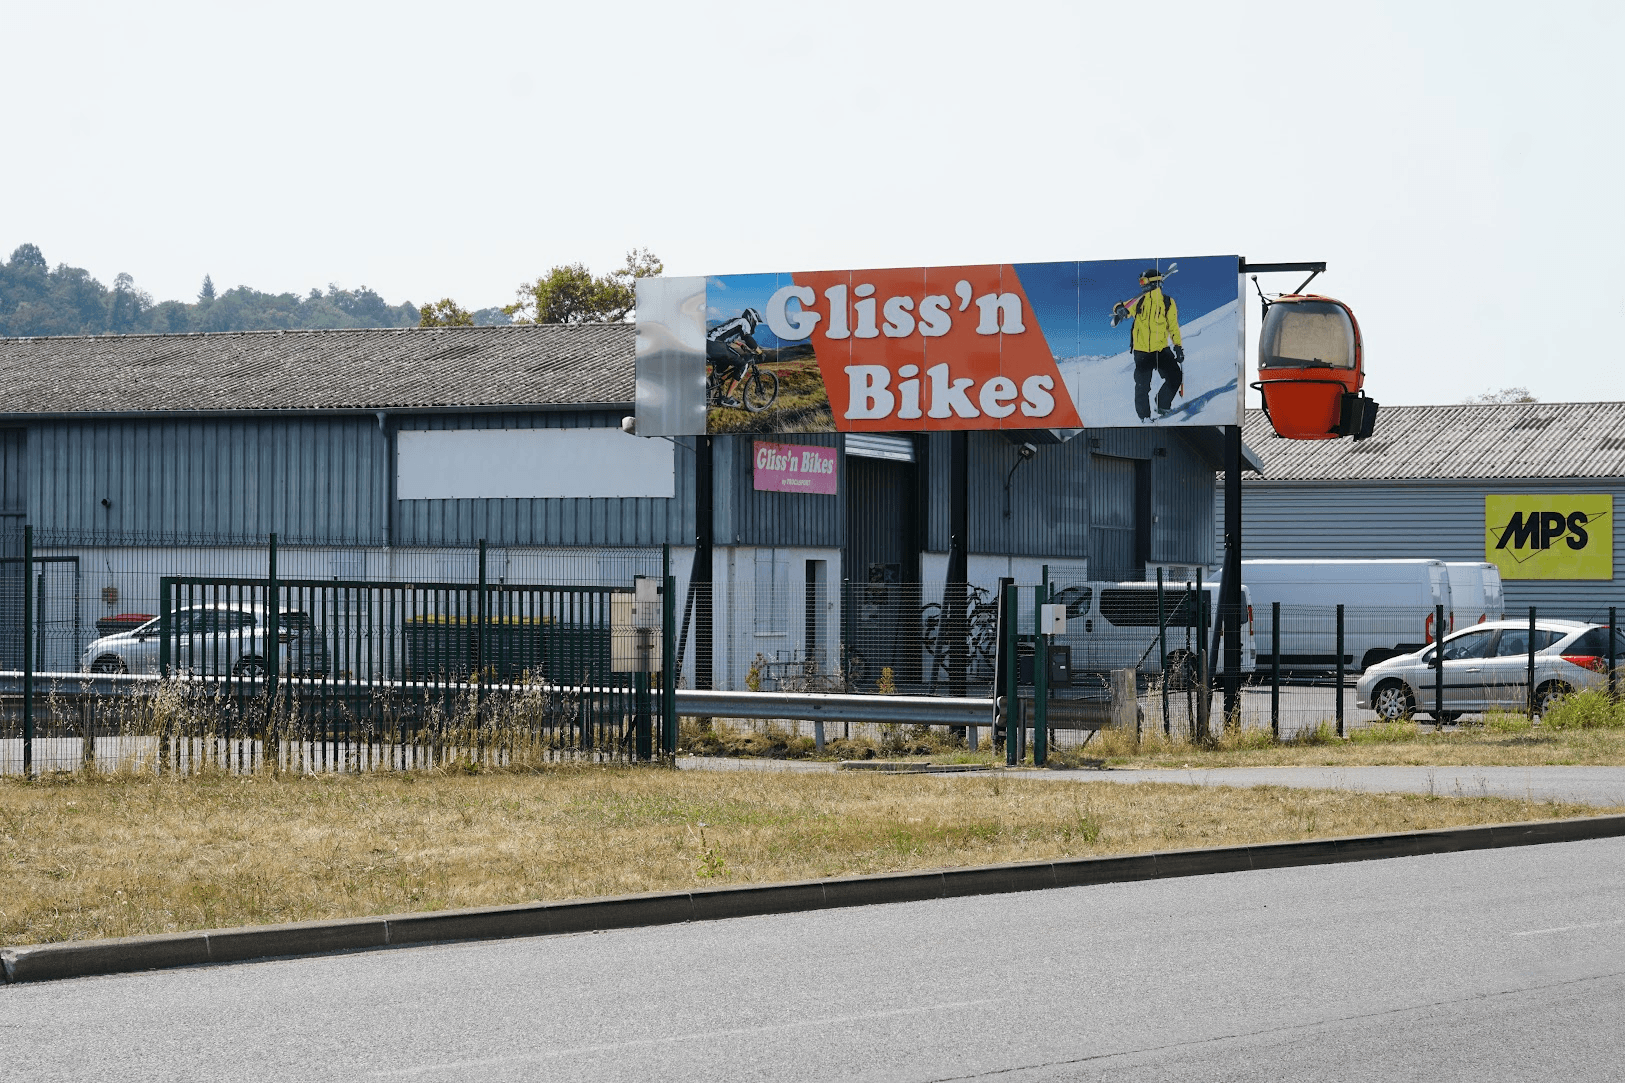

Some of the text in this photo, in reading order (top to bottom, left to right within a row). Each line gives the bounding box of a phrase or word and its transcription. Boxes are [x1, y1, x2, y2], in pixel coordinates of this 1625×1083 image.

[766, 280, 1026, 341] Gliss'n
[844, 362, 1055, 420] Bikes
[757, 448, 833, 474] Gliss'n Bikes
[1495, 511, 1588, 550] MPS
